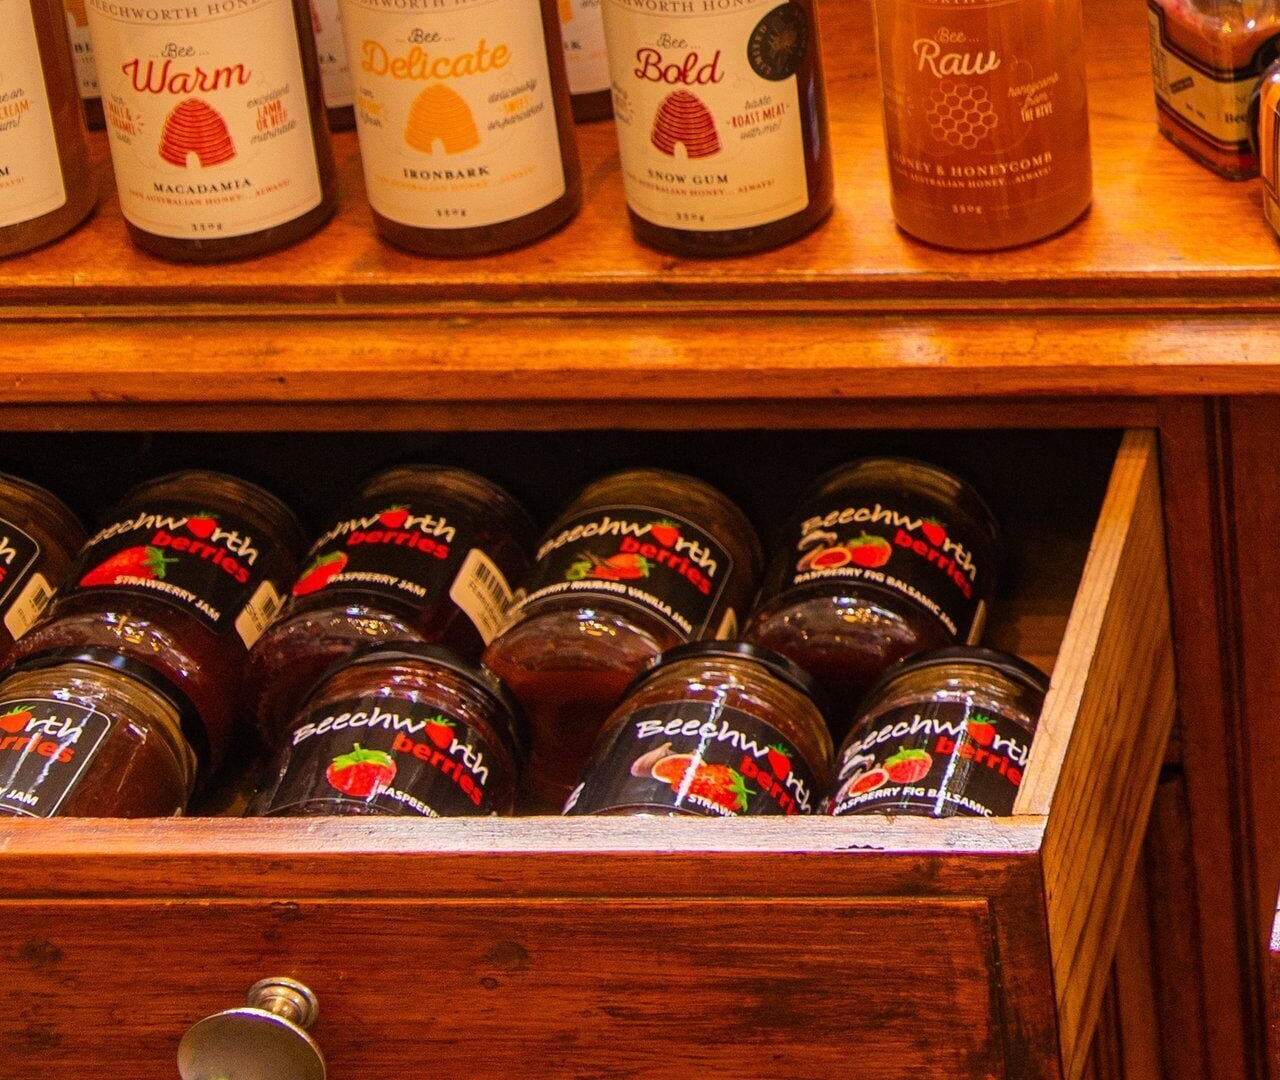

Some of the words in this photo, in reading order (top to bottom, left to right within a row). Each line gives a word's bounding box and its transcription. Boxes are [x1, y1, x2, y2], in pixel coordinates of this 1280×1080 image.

[161, 42, 196, 59] Bee
[407, 28, 442, 44] Bee
[655, 32, 689, 50] Bee
[360, 37, 513, 81] Delicate
[633, 47, 725, 87] Bold
[912, 37, 1002, 79] Raw
[121, 58, 252, 95] Warm
[402, 167, 490, 181] IRONBARK
[647, 169, 688, 185] SNOW
[692, 174, 729, 185] GUM
[950, 151, 1053, 178] HONEYCOMB
[152, 178, 252, 194] MACADAMIA
[151, 530, 251, 584] berries
[346, 530, 450, 560] berries
[619, 536, 712, 595] berries
[894, 529, 973, 600] berries
[113, 575, 196, 603] STRAWBERRY
[194, 599, 221, 622] JAM
[397, 579, 427, 598] JAM
[793, 567, 864, 585] RASPBERRY
[863, 569, 886, 583] FIG
[886, 576, 942, 616] BALSAMIC
[391, 732, 484, 806] berries
[6, 786, 40, 808] JAM
[903, 786, 924, 799] FIG
